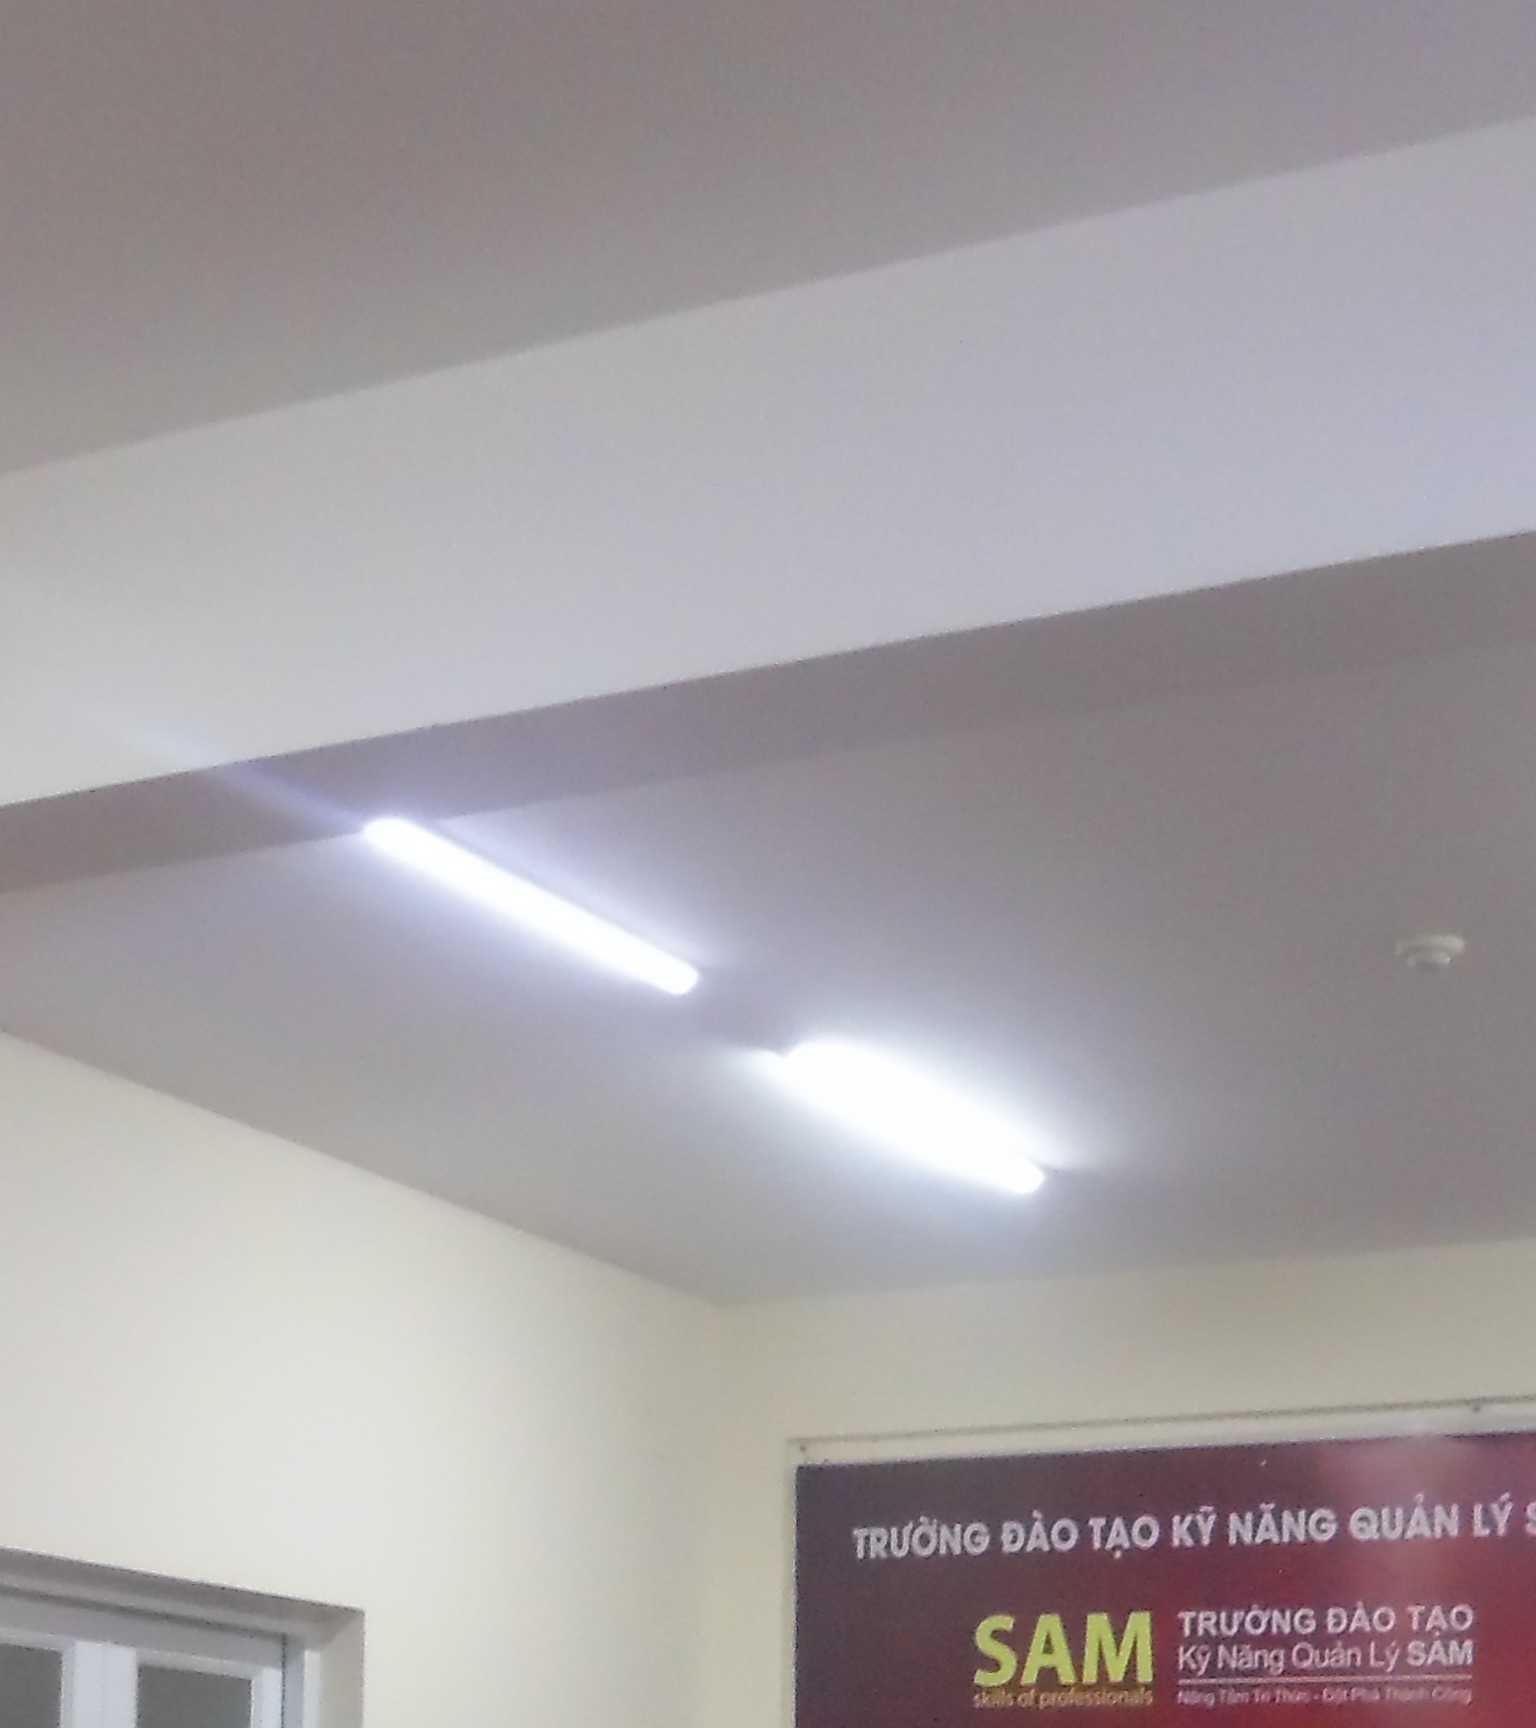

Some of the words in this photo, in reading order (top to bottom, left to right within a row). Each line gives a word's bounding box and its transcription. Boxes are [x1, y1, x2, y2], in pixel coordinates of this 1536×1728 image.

[853, 1514, 991, 1558] TRƯỜNG
[1000, 1509, 1079, 1554] ĐÀO
[1088, 1514, 1160, 1559] TẠO
[1171, 1505, 1217, 1548] KỸ
[1228, 1502, 1338, 1545] NĂNG
[1349, 1492, 1460, 1541] QUẢN
[1473, 1492, 1513, 1537] LÝ
[1177, 1603, 1316, 1637] TRƯỜNG
[1326, 1600, 1396, 1633] ĐÀO
[1407, 1602, 1474, 1636] TẠO
[973, 1611, 1154, 1687] SAM
[1178, 1643, 1211, 1675] Kỹ
[1217, 1643, 1285, 1675] Năng
[1292, 1641, 1362, 1669] Quản
[1369, 1640, 1400, 1672] Lý
[1407, 1639, 1474, 1667] SAM
[973, 1689, 1013, 1707] skills
[1039, 1687, 1154, 1709] professionals
